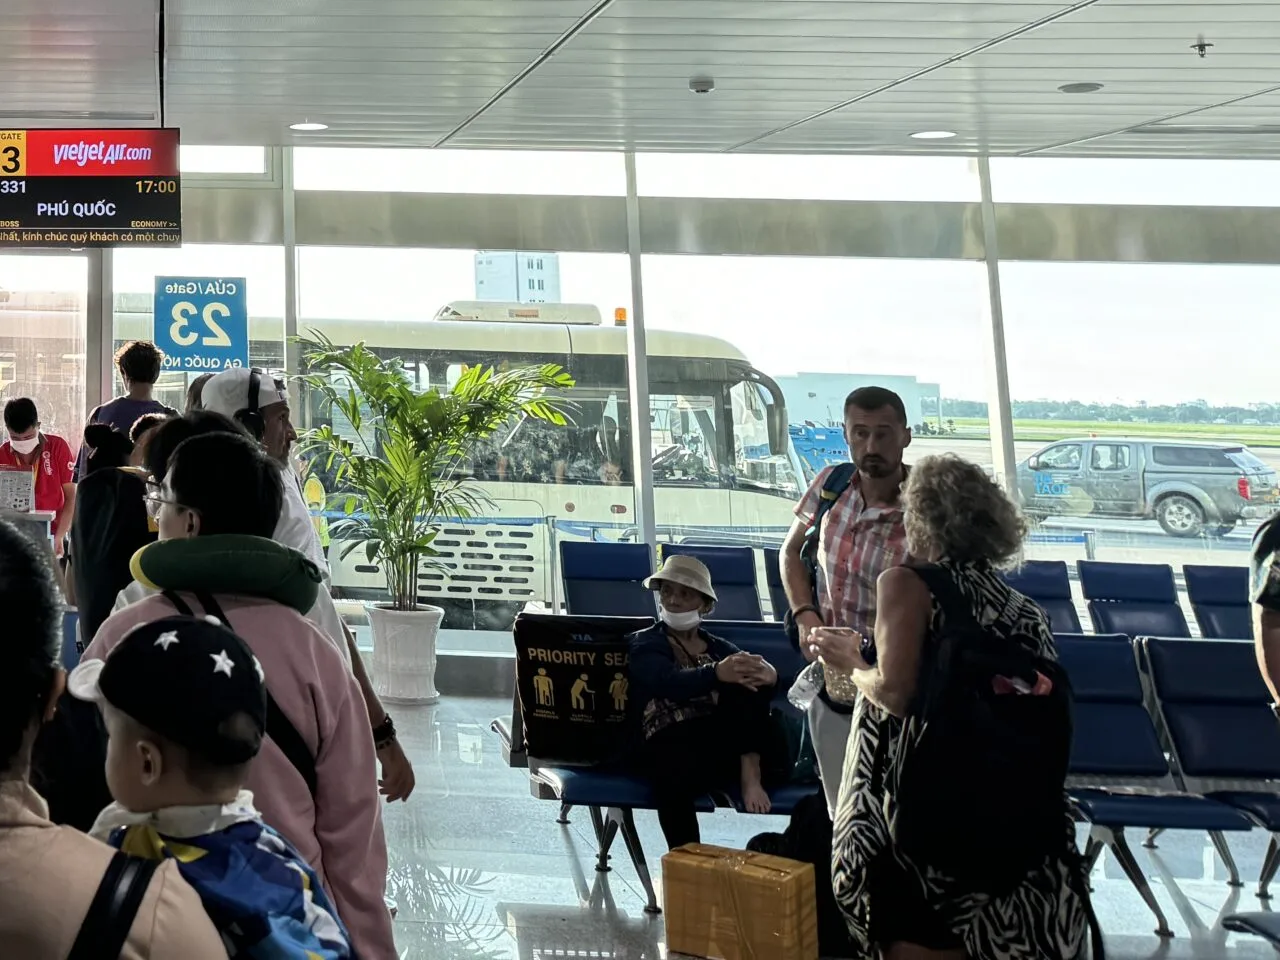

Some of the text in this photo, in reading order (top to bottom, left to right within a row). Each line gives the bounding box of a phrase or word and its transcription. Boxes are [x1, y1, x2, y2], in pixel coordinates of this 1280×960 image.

[0, 180, 26, 193] 331
[135, 180, 176, 193] 17:00
[37, 199, 116, 217] PHÚ QUỐC
[131, 220, 168, 228] ECONOMY
[22, 231, 42, 241] kính
[44, 231, 68, 241] chúc
[70, 232, 88, 243] quý
[89, 232, 119, 241] khách
[121, 232, 133, 241] có
[527, 647, 596, 666] PRIORITY
